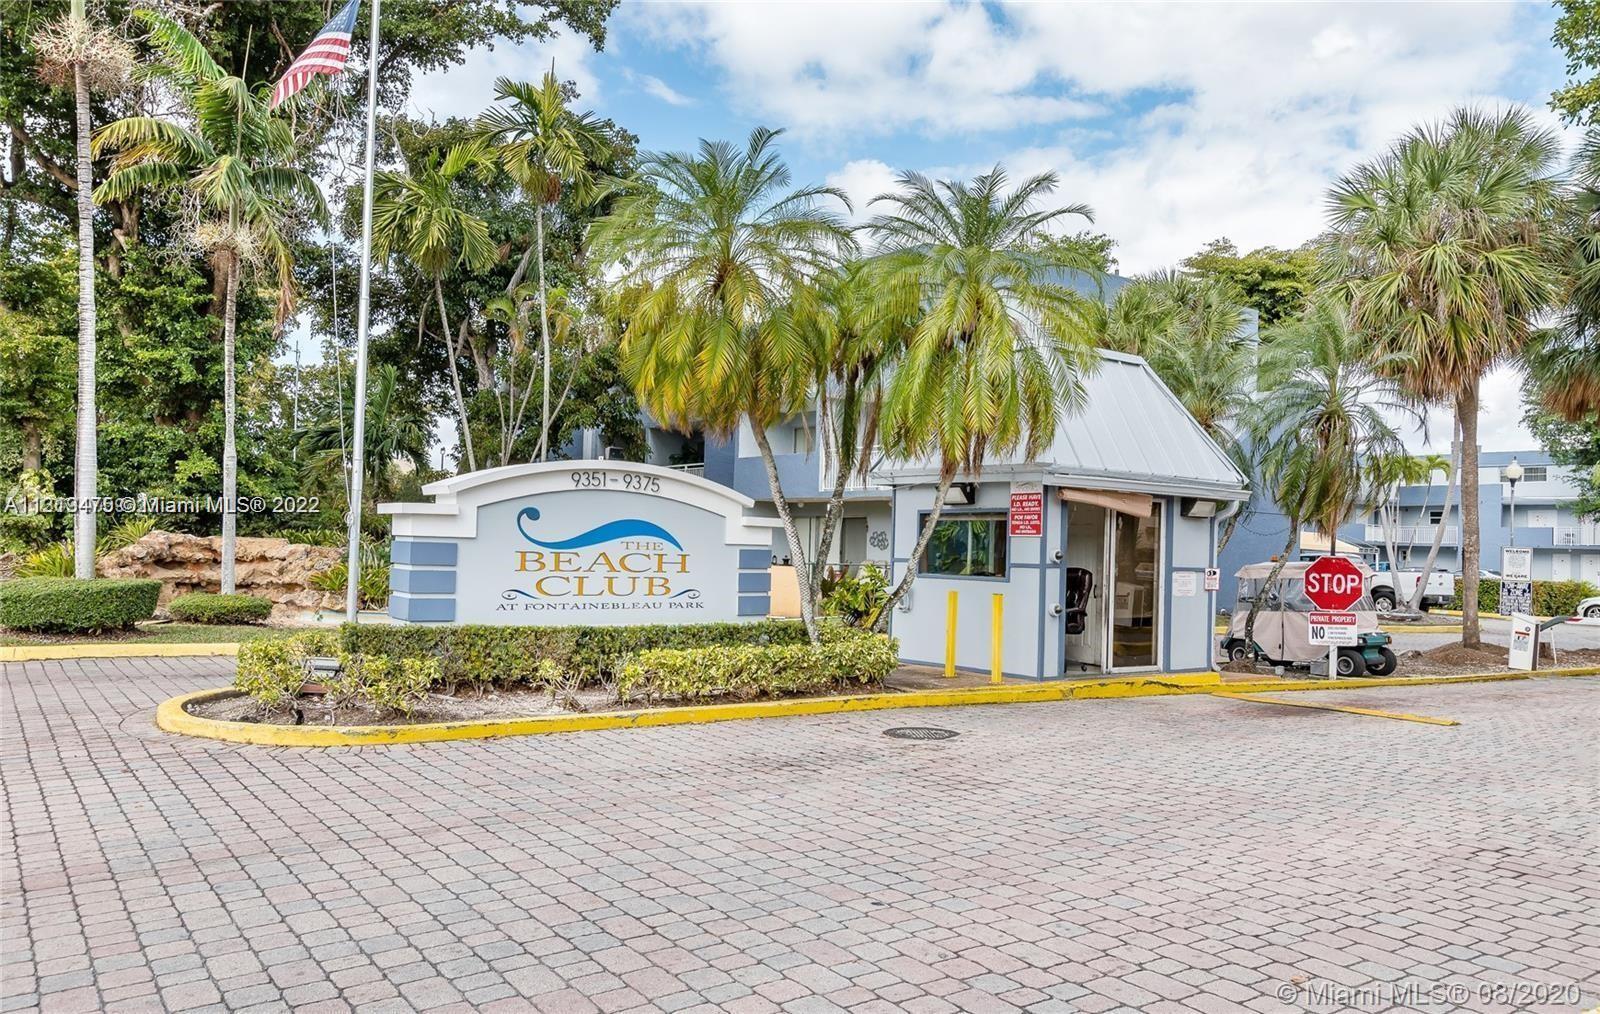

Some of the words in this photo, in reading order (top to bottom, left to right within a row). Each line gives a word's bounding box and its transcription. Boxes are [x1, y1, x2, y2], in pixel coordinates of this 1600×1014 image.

[621, 541, 663, 550] THE
[514, 550, 690, 573] BEACH
[535, 576, 671, 597] CLUB
[1308, 573, 1359, 594] STOP
[496, 603, 519, 611] AT
[524, 602, 663, 611] FONTAINEBLEAU
[669, 601, 704, 609] PARK
[1310, 615, 1330, 623] PRIVATE
[1331, 615, 1356, 623] PROPERTY
[1312, 626, 1325, 639] NO
